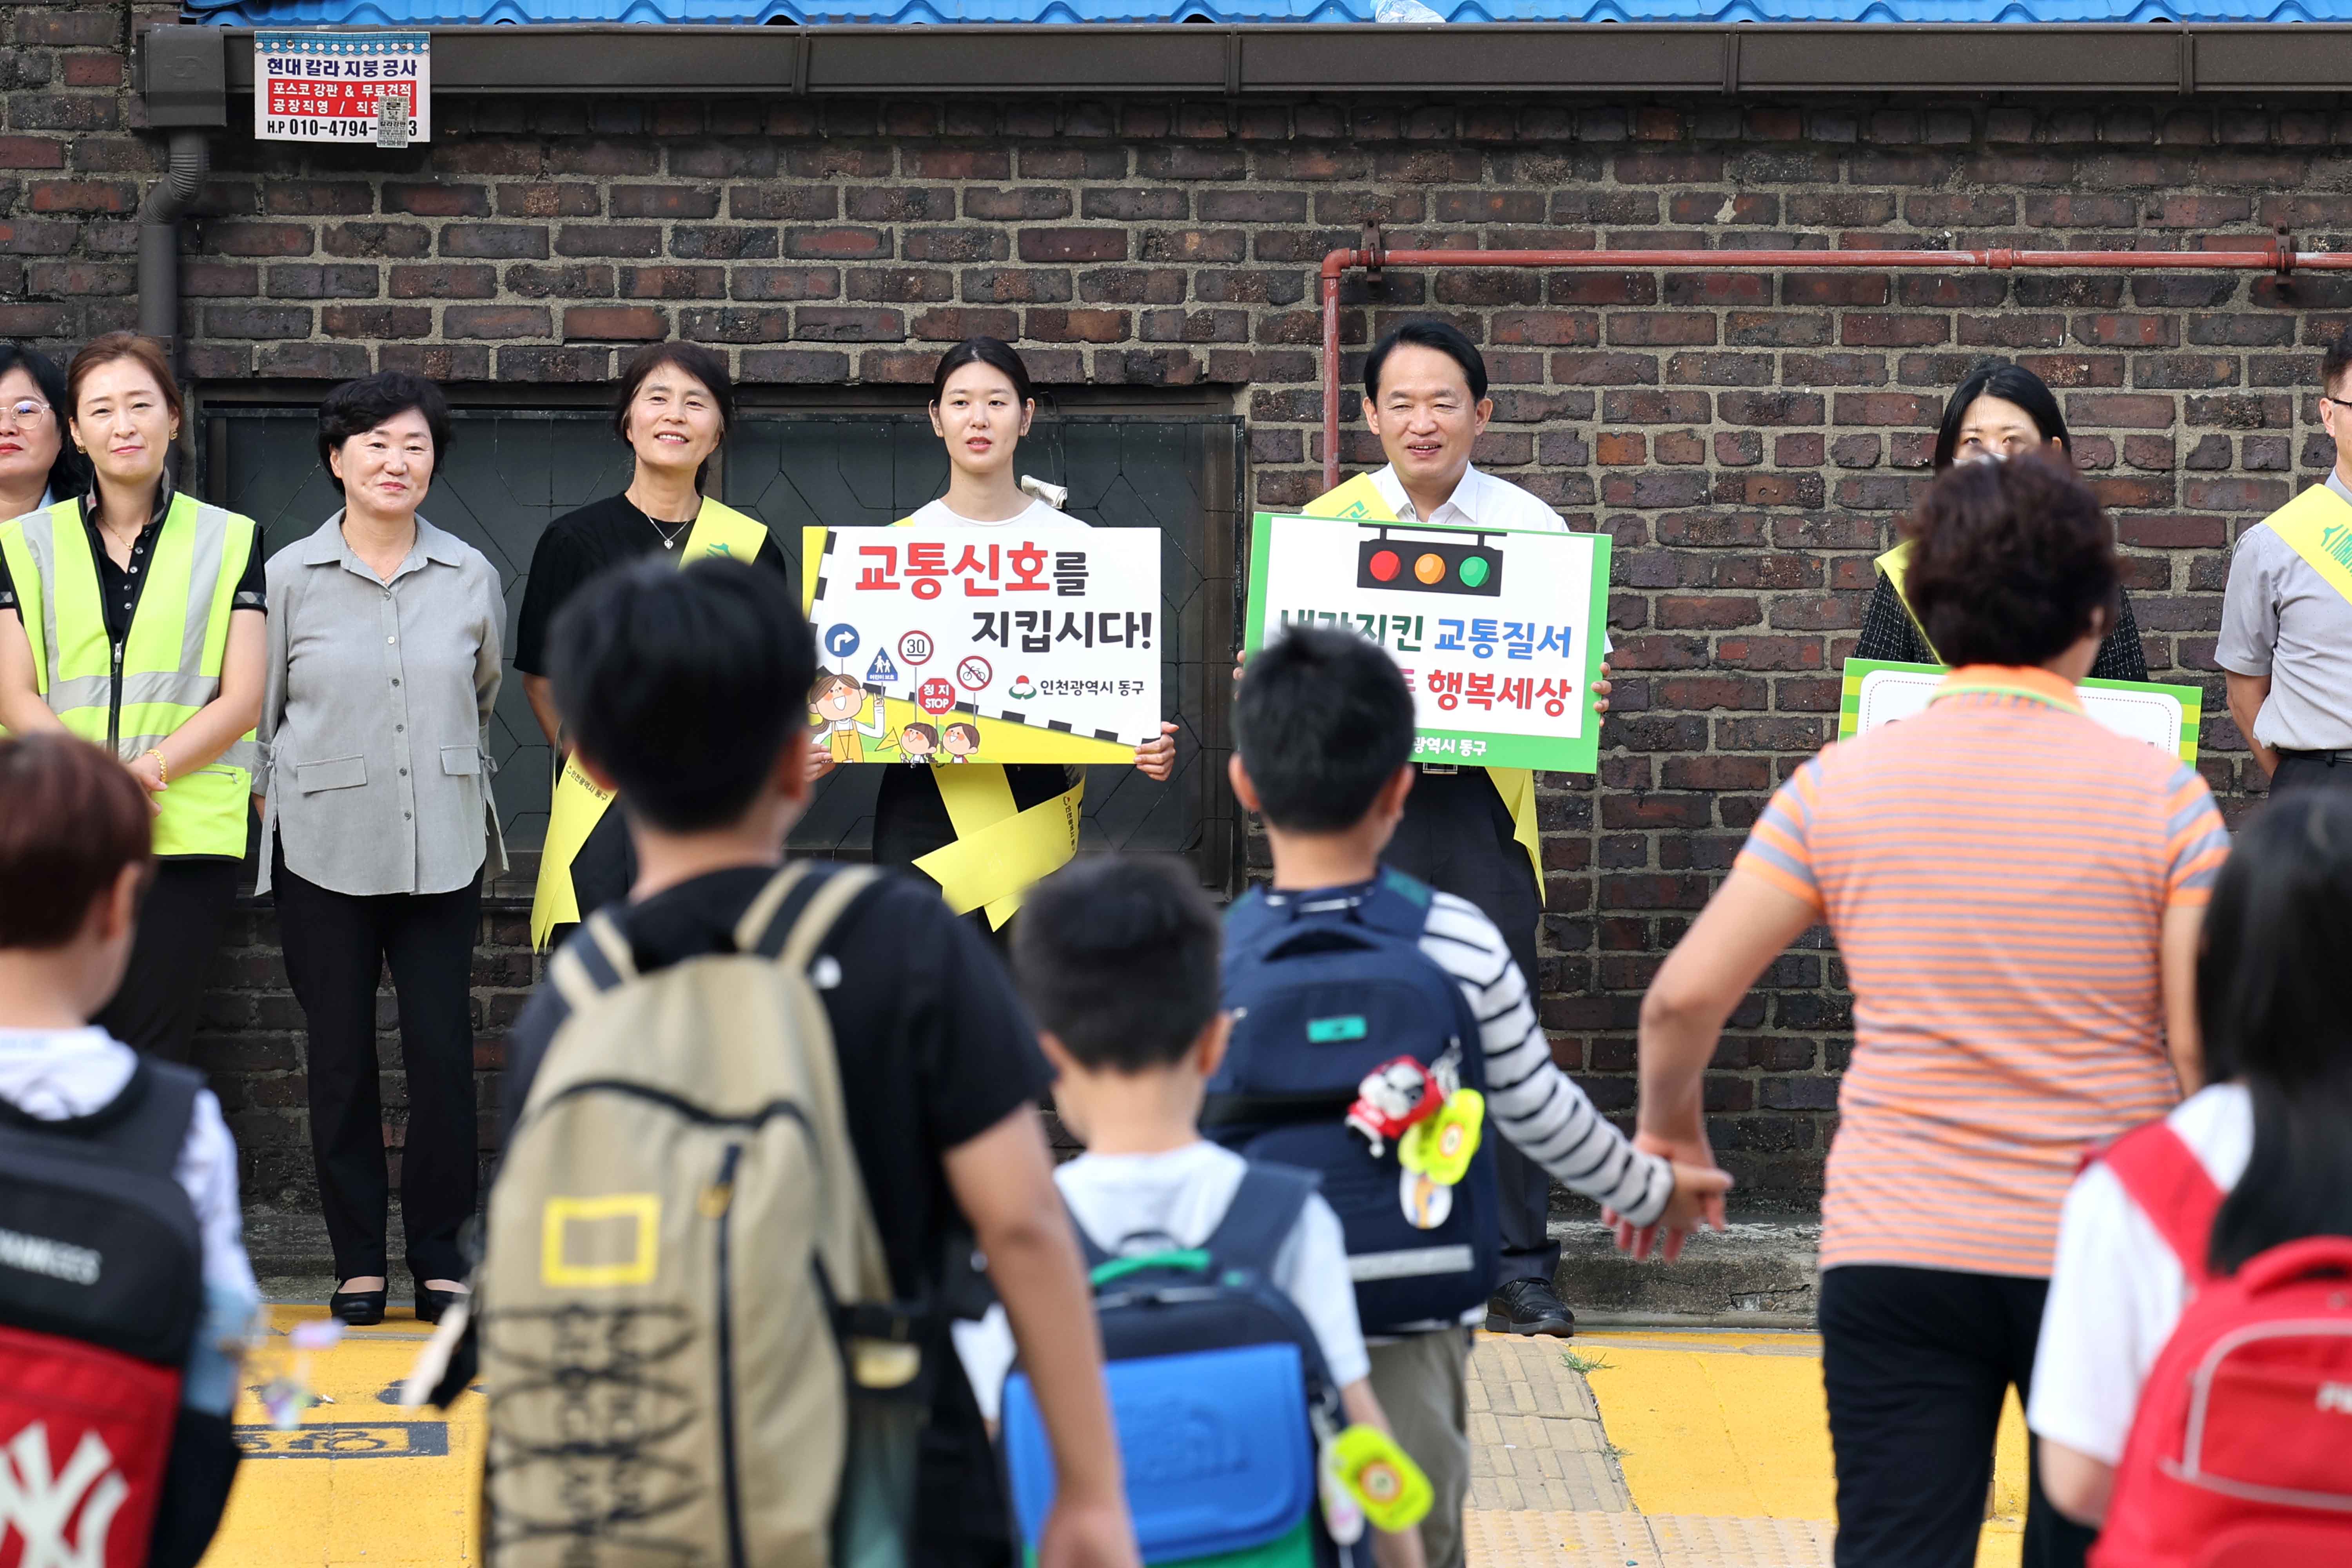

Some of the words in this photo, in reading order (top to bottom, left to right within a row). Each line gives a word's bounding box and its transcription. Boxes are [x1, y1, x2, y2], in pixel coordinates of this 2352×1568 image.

[267, 58, 301, 75] 현대
[306, 59, 340, 77] 칼라
[344, 60, 378, 77] 지붕
[383, 60, 417, 77] 공사
[273, 83, 310, 95] 포스코
[314, 83, 338, 97] 강판
[345, 85, 354, 97] &
[362, 83, 411, 97] 무료견적
[273, 99, 328, 114] 공장직영
[267, 120, 285, 134] H.P
[290, 119, 417, 137] 010-4794-3
[855, 541, 1089, 600] 교통신호를
[971, 610, 1152, 652] 지킵시다!
[1434, 618, 1572, 660] 교통질서
[907, 639, 925, 653] 30
[1040, 680, 1113, 696] 인천광역시
[1118, 680, 1144, 696] 동구
[1427, 669, 1572, 717] 행복세상
[925, 698, 949, 708] STOP
[1414, 736, 1456, 755] 광역시
[1459, 739, 1487, 757] 동구
